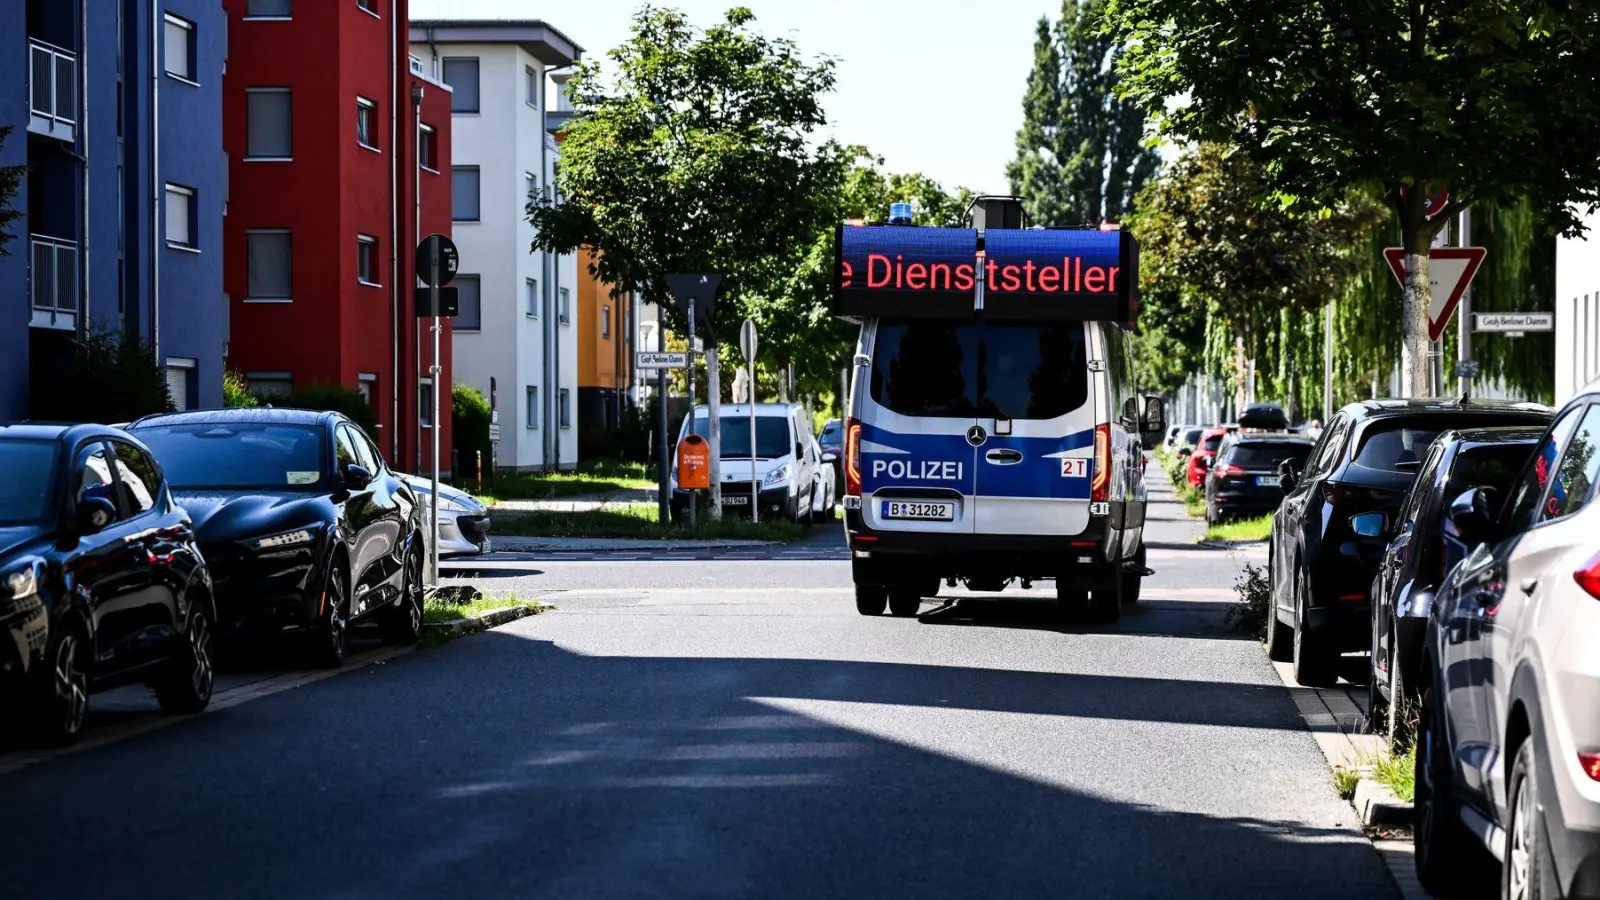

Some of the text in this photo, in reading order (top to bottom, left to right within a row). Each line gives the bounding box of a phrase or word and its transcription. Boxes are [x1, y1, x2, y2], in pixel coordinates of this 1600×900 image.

[1525, 315, 1548, 325] Damm
[872, 460, 963, 480] POLIZEI
[891, 503, 946, 517] B 31282
